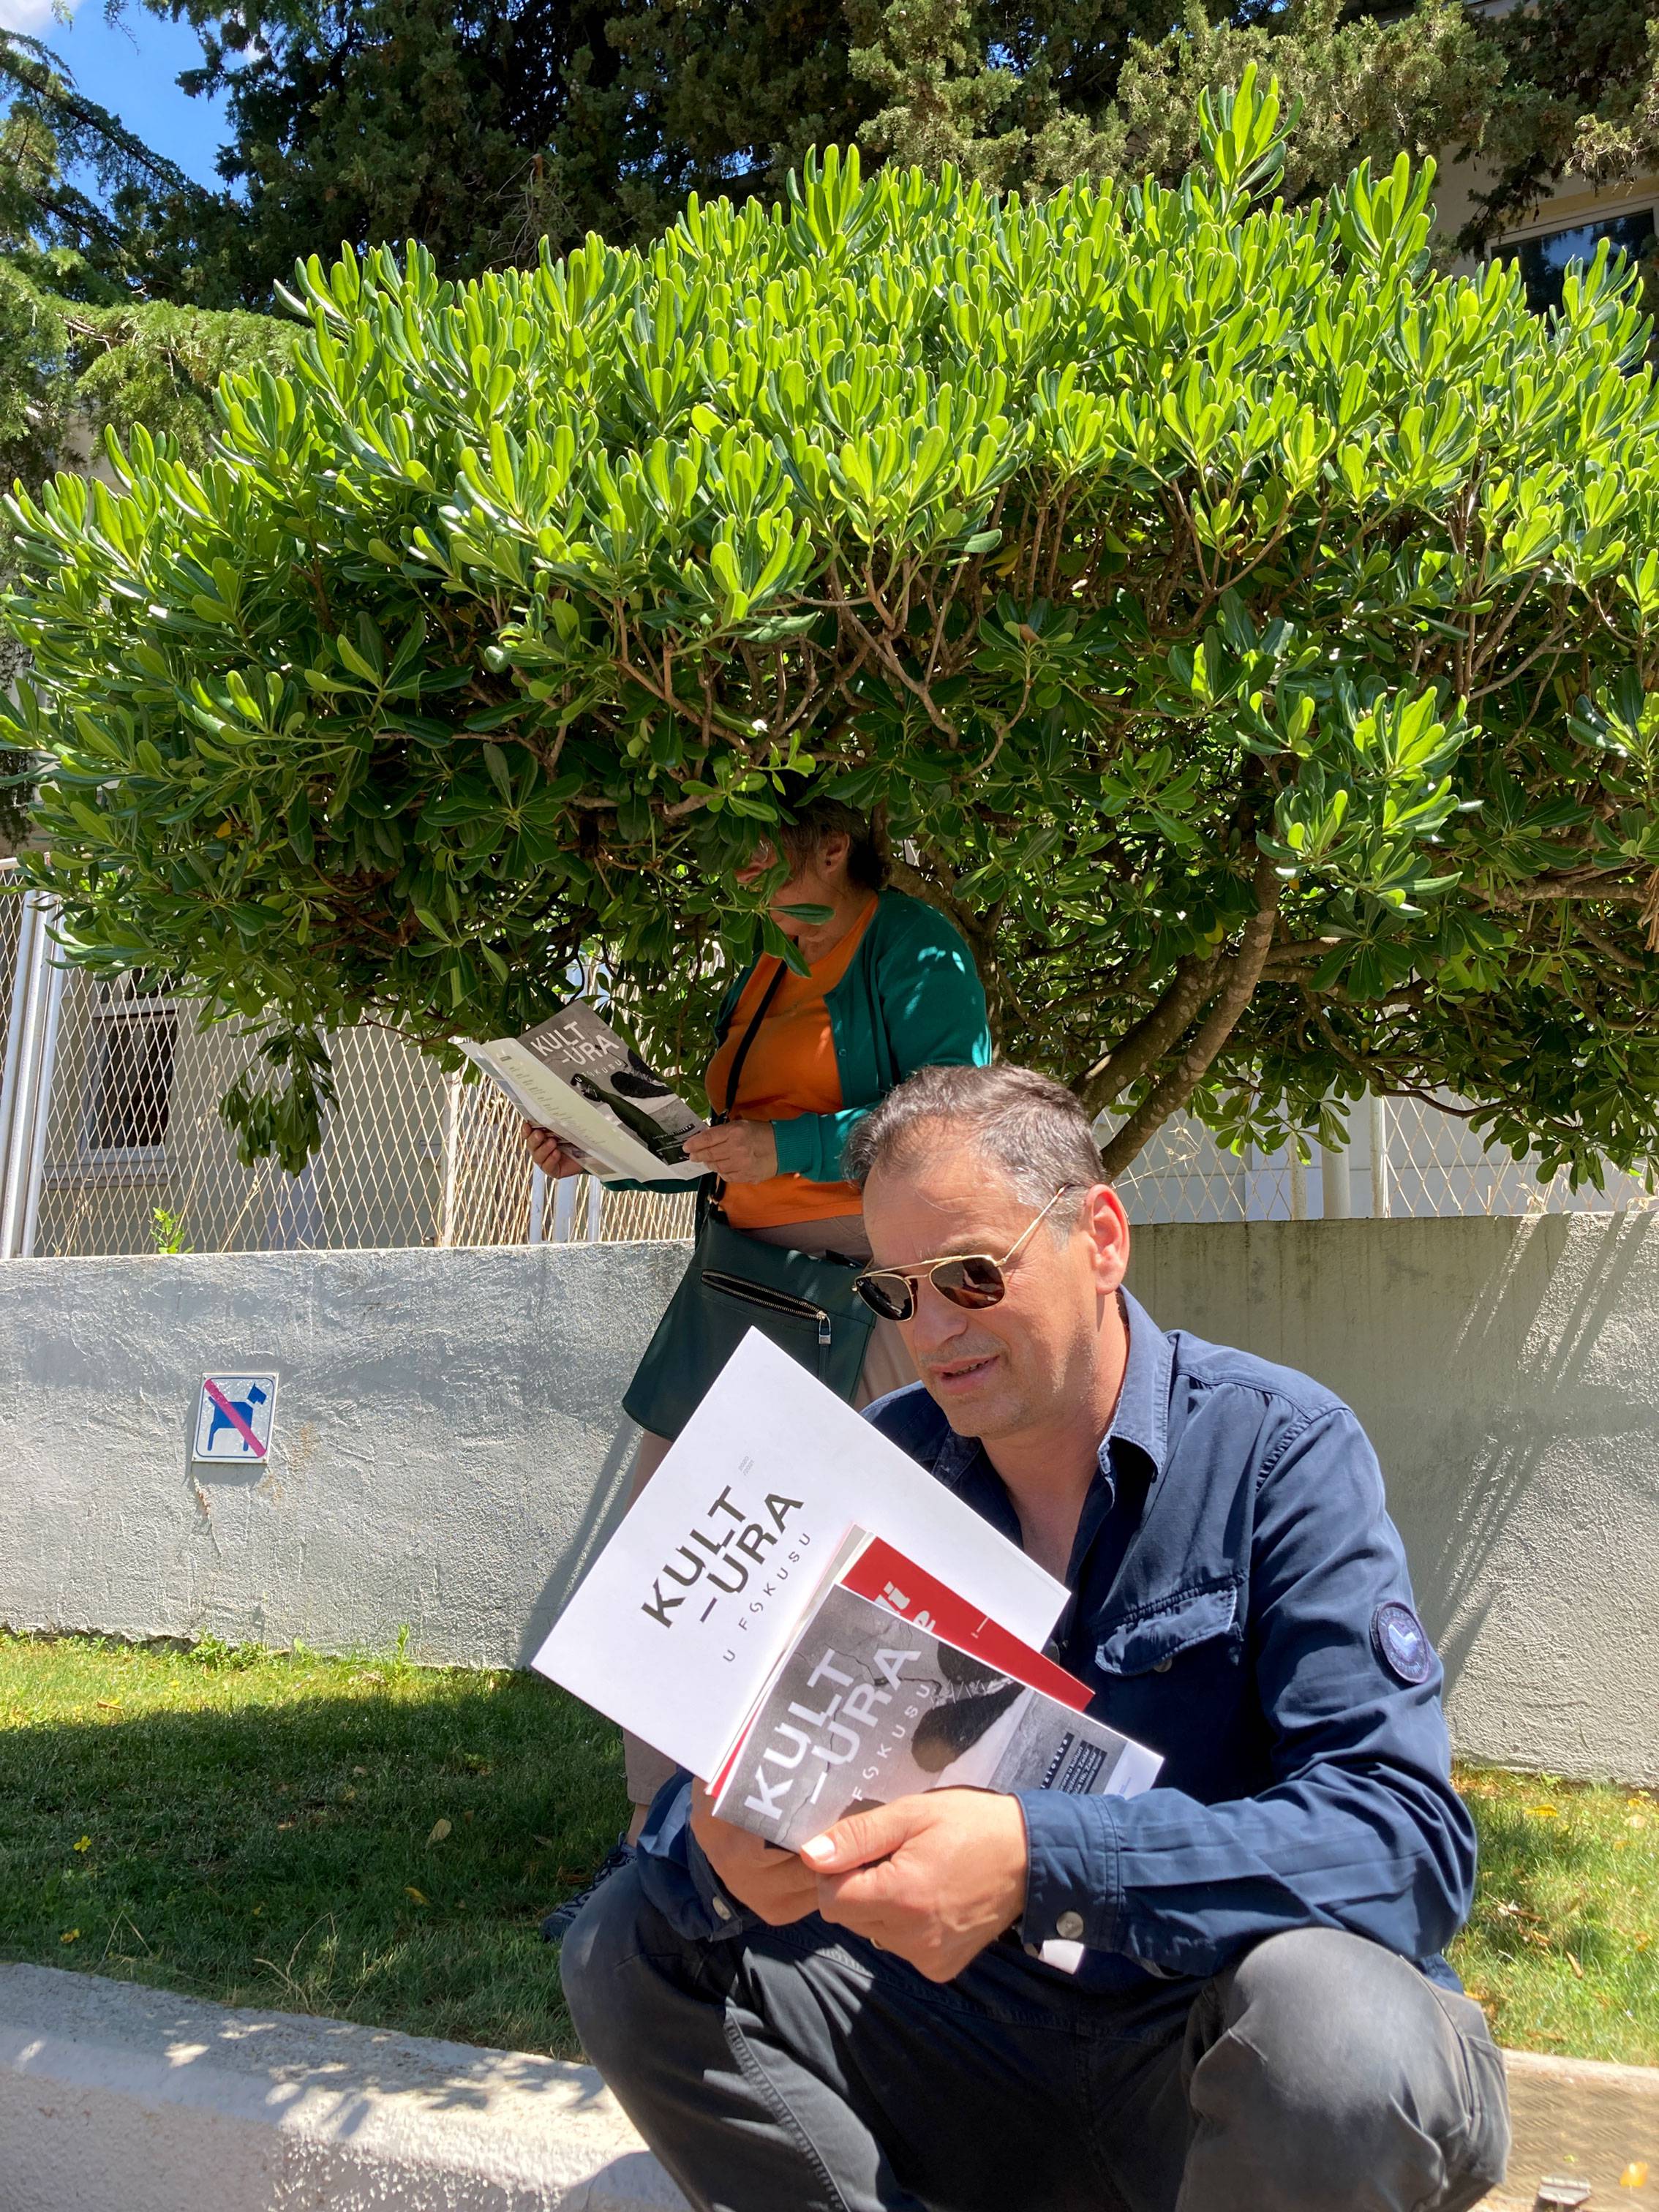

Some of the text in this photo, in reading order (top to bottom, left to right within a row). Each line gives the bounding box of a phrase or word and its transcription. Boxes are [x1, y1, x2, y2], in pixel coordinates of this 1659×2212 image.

[530, 1021, 585, 1056] KULT
[642, 1485, 746, 1628] KULT
[723, 1533, 810, 1662] U FOKUSU
[744, 1648, 854, 1820] KULT
[1077, 1748, 1090, 1768] Zadar
[1085, 1752, 1096, 1771] Zadar
